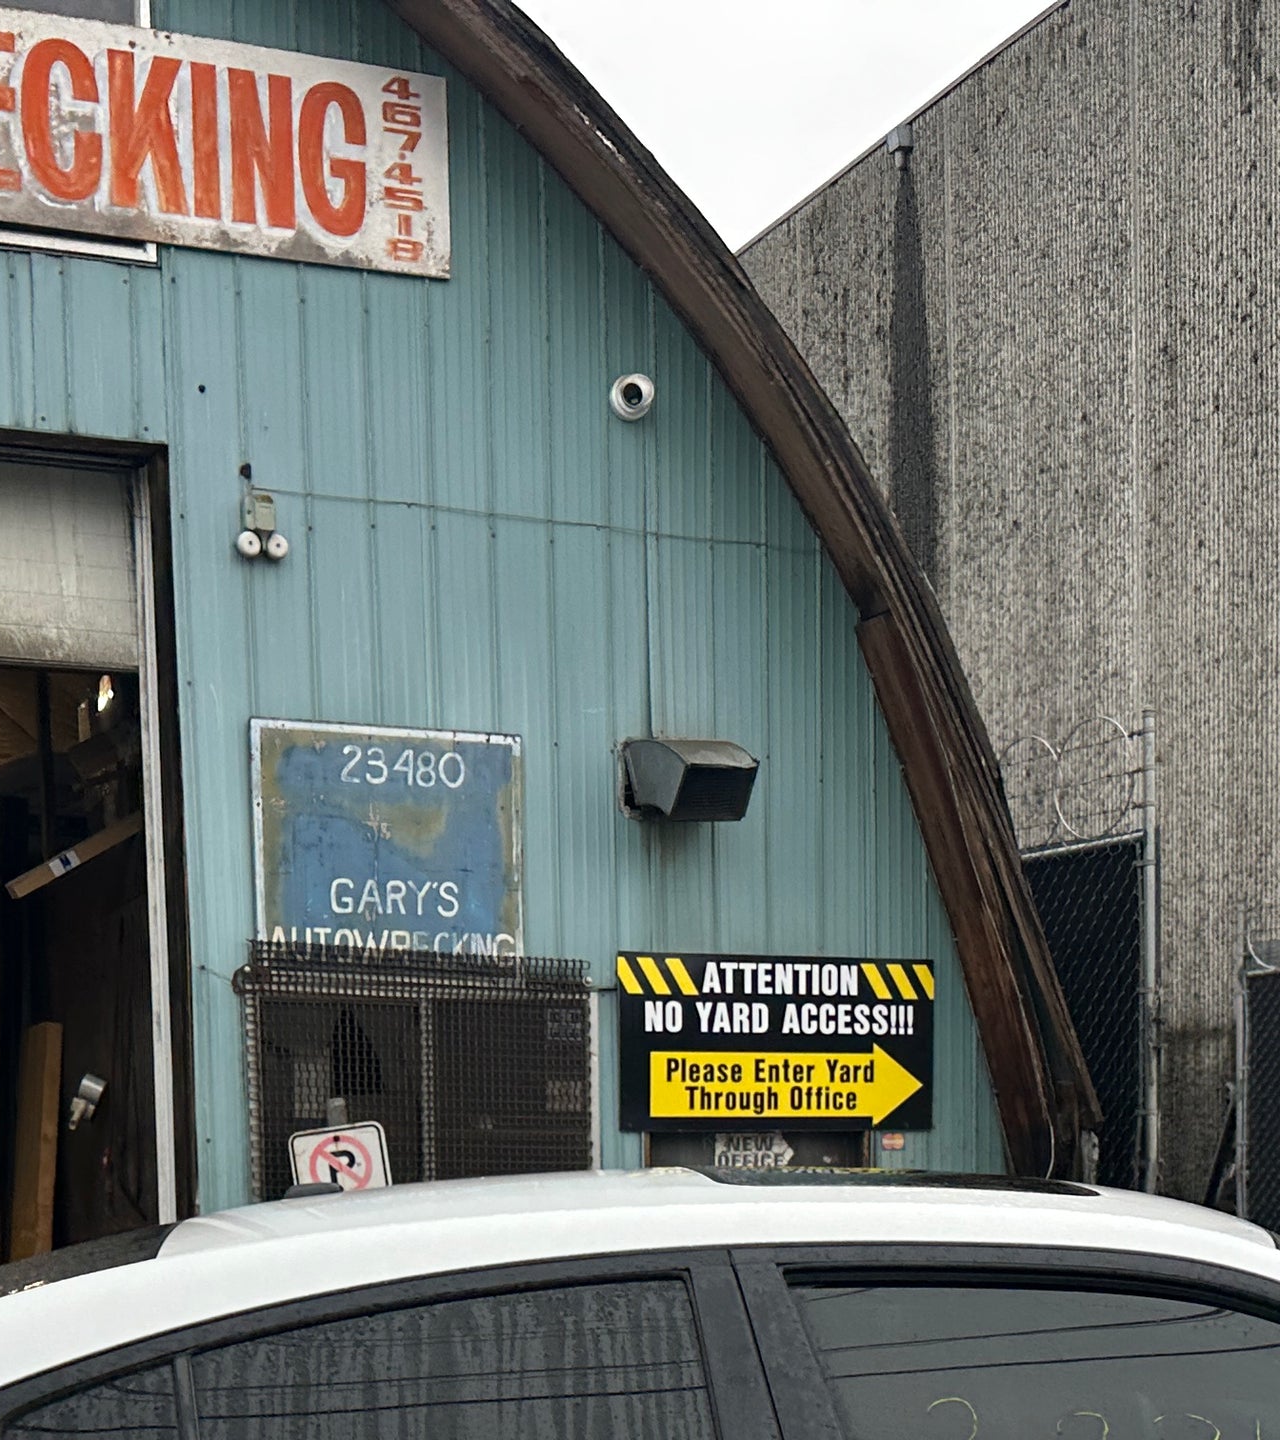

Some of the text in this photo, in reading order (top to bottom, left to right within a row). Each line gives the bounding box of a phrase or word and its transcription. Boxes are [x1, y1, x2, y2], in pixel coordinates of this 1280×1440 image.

[340, 744, 466, 788] 23480
[330, 877, 460, 918] GARY'S
[701, 961, 858, 996] ATTENTION
[644, 1000, 914, 1035] NO YARD ACCESS!!!
[666, 1058, 875, 1084] Please Enter Yard
[685, 1085, 857, 1115] Through Office
[726, 1134, 772, 1151] NEW
